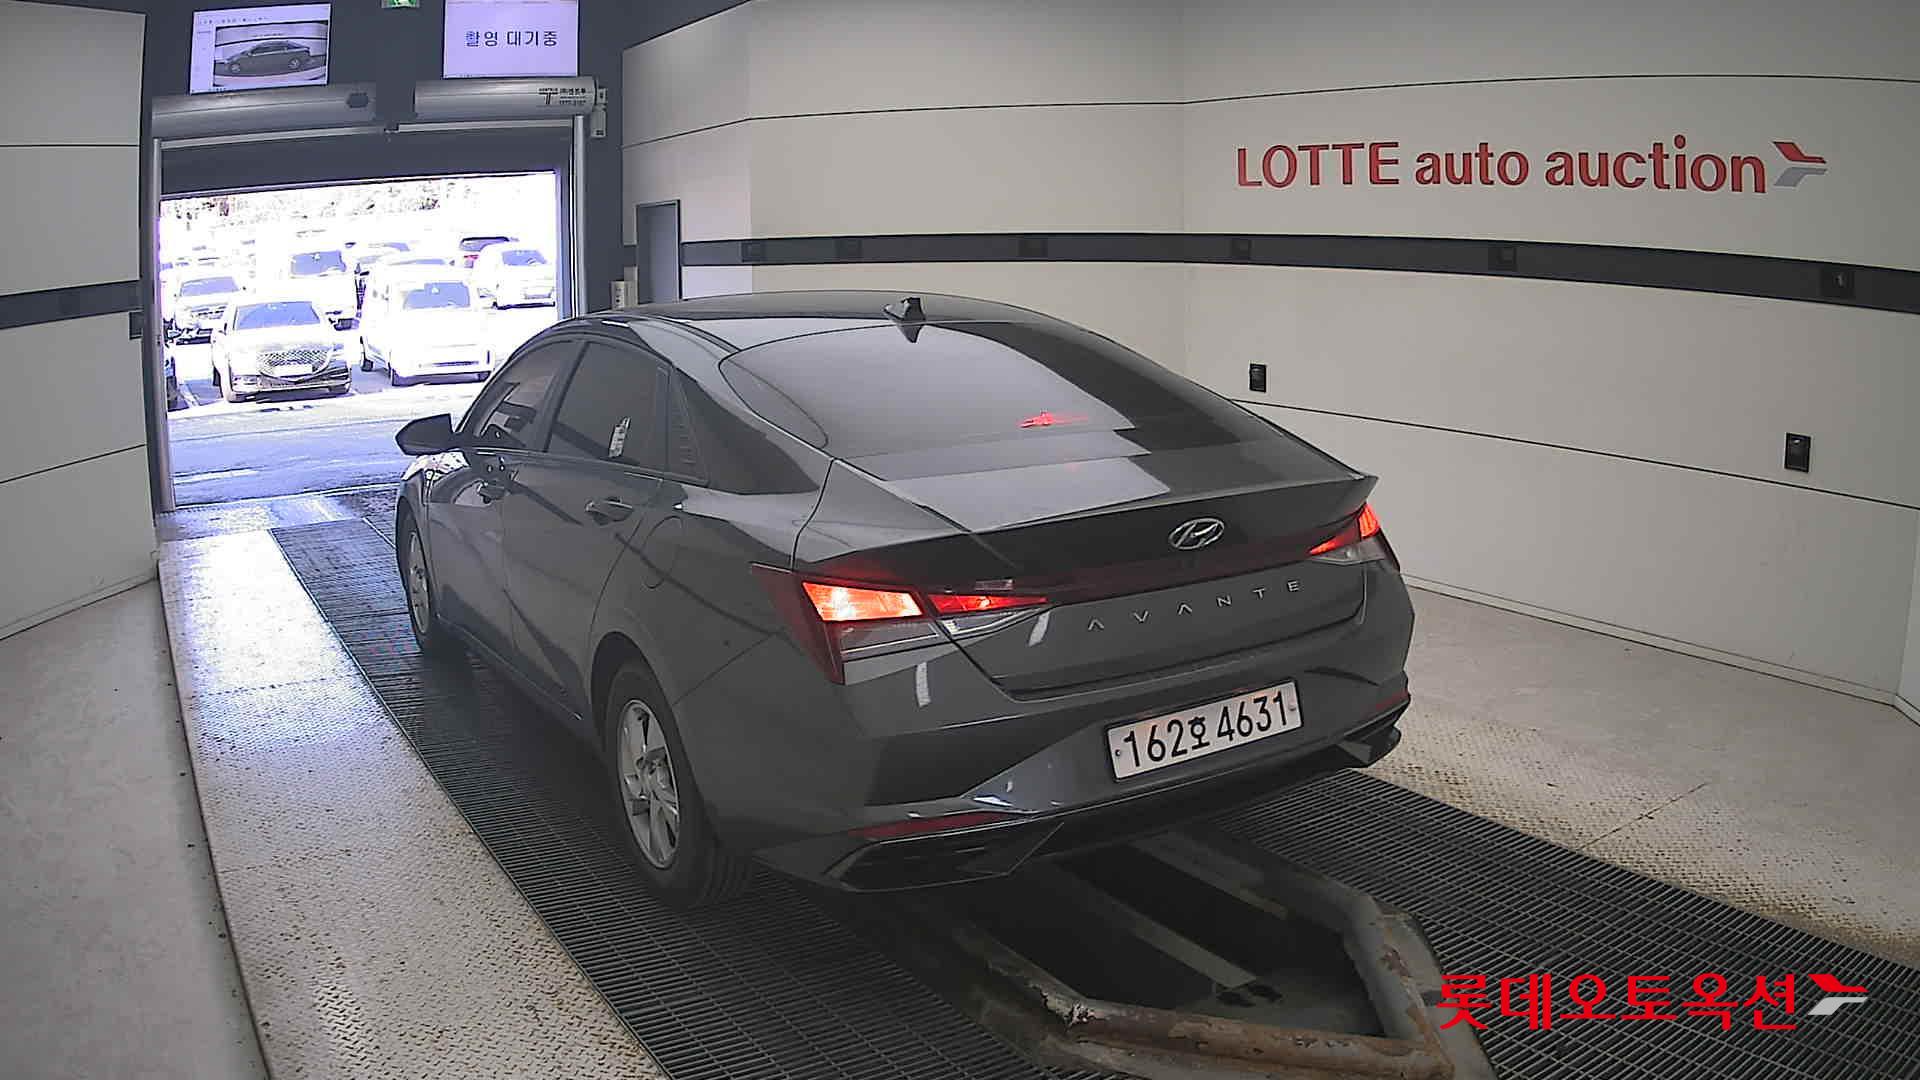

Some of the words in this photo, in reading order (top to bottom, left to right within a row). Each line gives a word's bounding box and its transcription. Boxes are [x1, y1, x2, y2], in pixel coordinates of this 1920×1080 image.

[506, 30, 557, 47] 대기중
[1237, 141, 1400, 188] LOTTE
[1415, 142, 1530, 185] auto
[1545, 135, 1767, 193] auction
[1088, 579, 1301, 631] AVANTE
[1216, 690, 1287, 742] 4631
